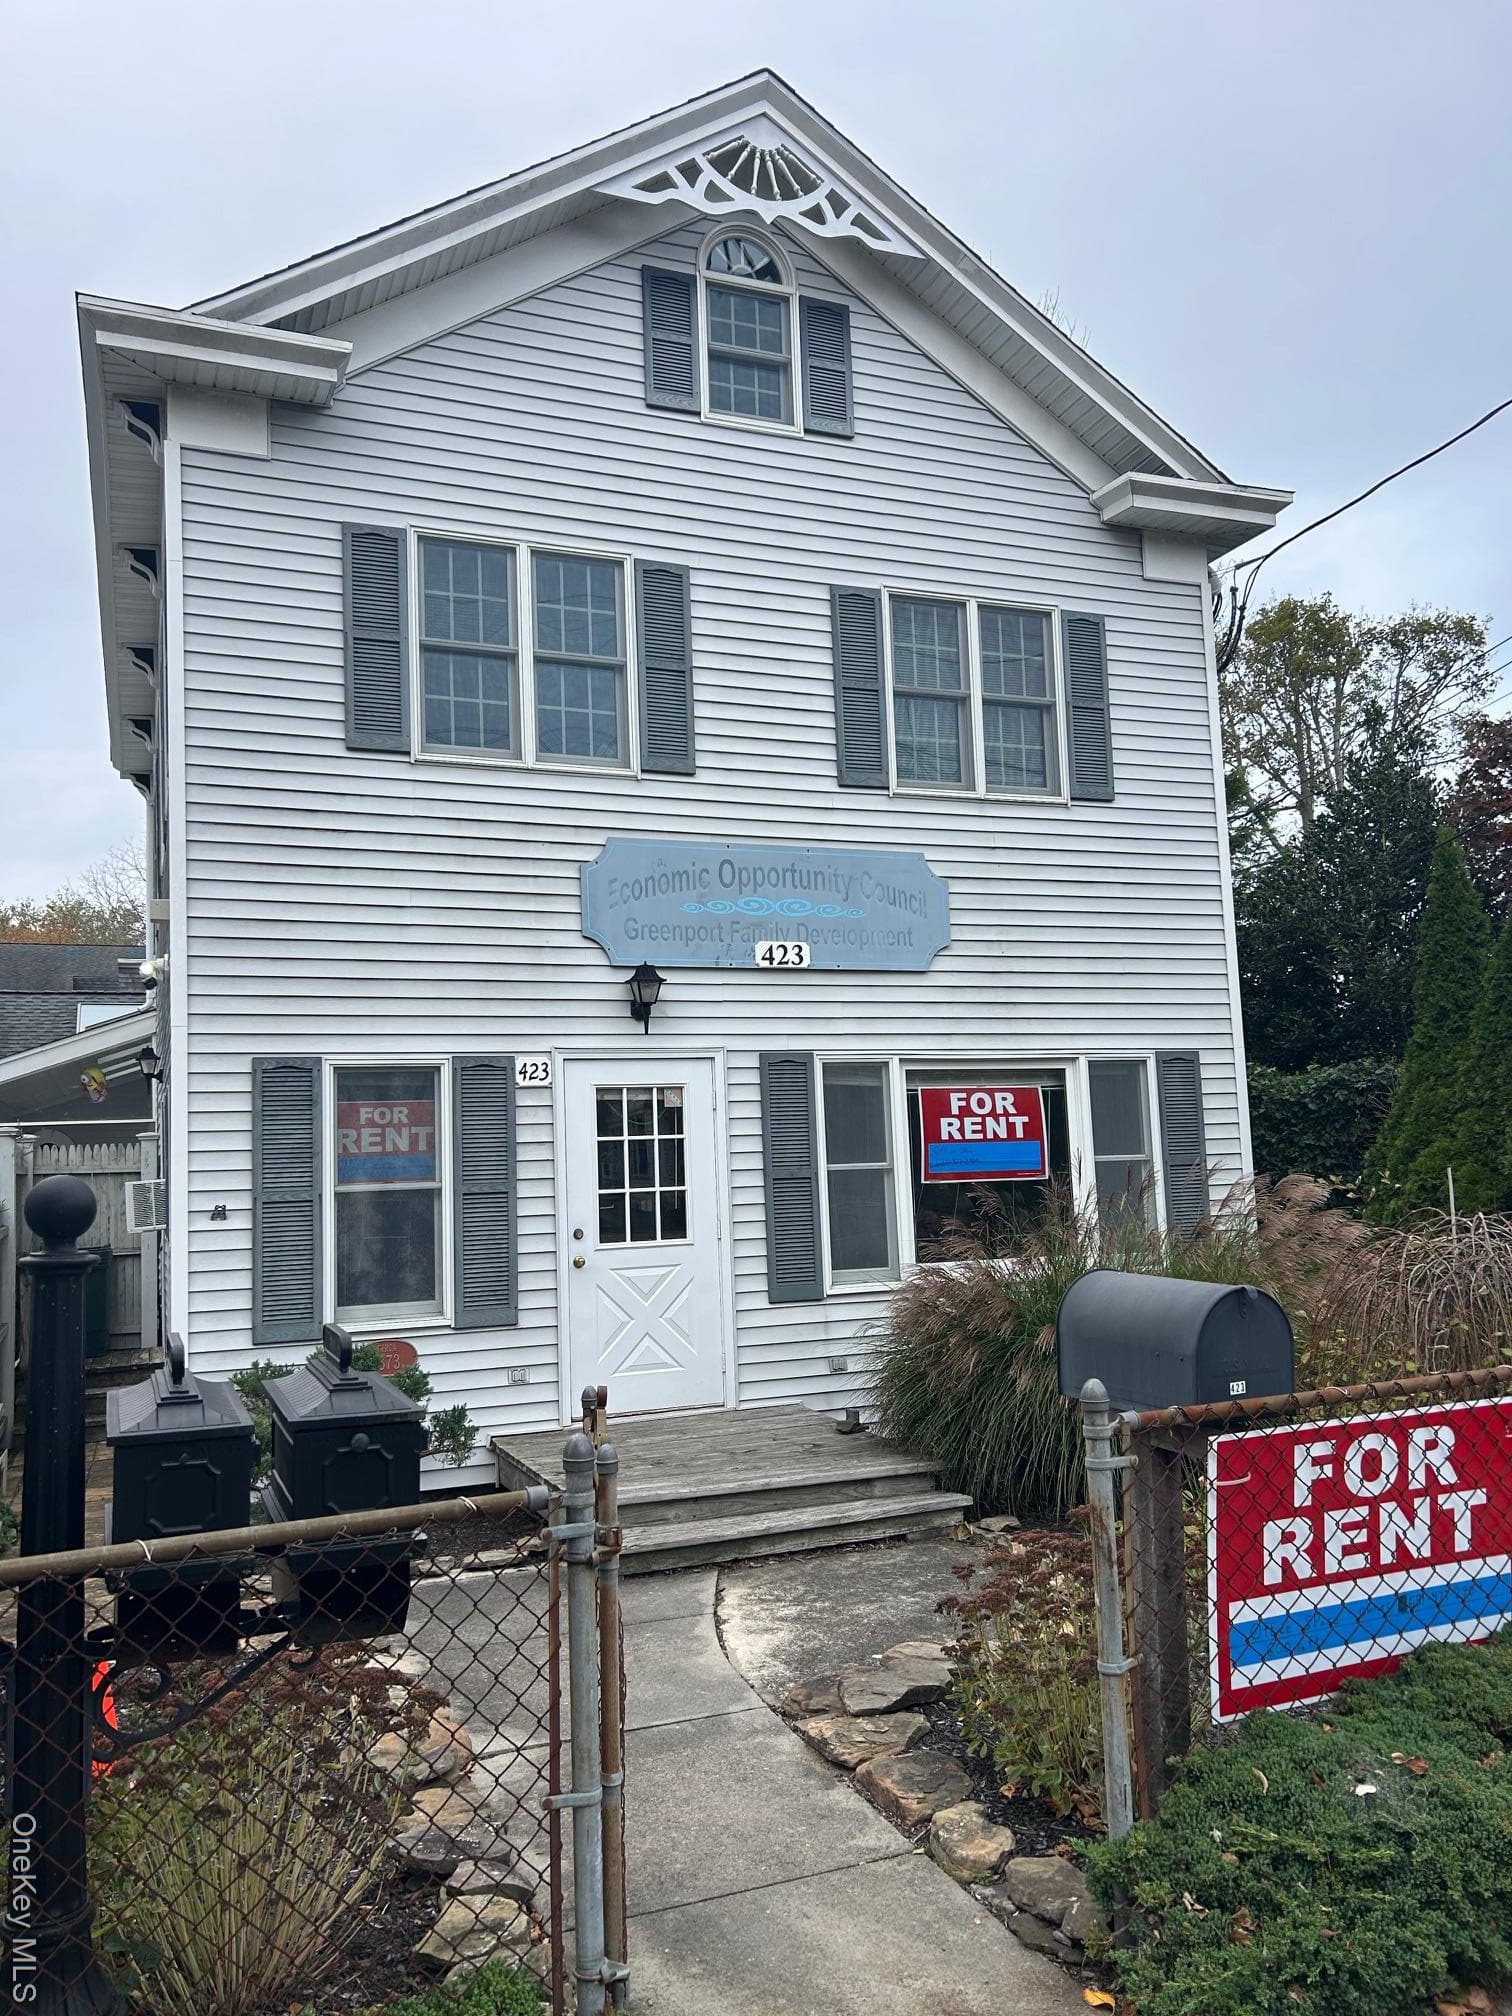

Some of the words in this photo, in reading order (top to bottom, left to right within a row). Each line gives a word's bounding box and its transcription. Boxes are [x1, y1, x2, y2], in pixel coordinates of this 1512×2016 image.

[607, 860, 711, 910] Economic
[718, 858, 852, 902] Opportunity
[860, 870, 928, 919] Council
[624, 916, 725, 947] Greenport
[731, 920, 790, 942] Family
[797, 921, 914, 950] Development
[761, 944, 804, 966] 423
[518, 1062, 550, 1082] 423
[950, 1091, 1017, 1115] FOR
[359, 1106, 409, 1125] FOR
[337, 1126, 434, 1154] RENT
[940, 1116, 1029, 1140] RENT
[1230, 1382, 1245, 1394] 423
[1293, 1425, 1459, 1508] FOR
[1262, 1488, 1487, 1587] RENT
